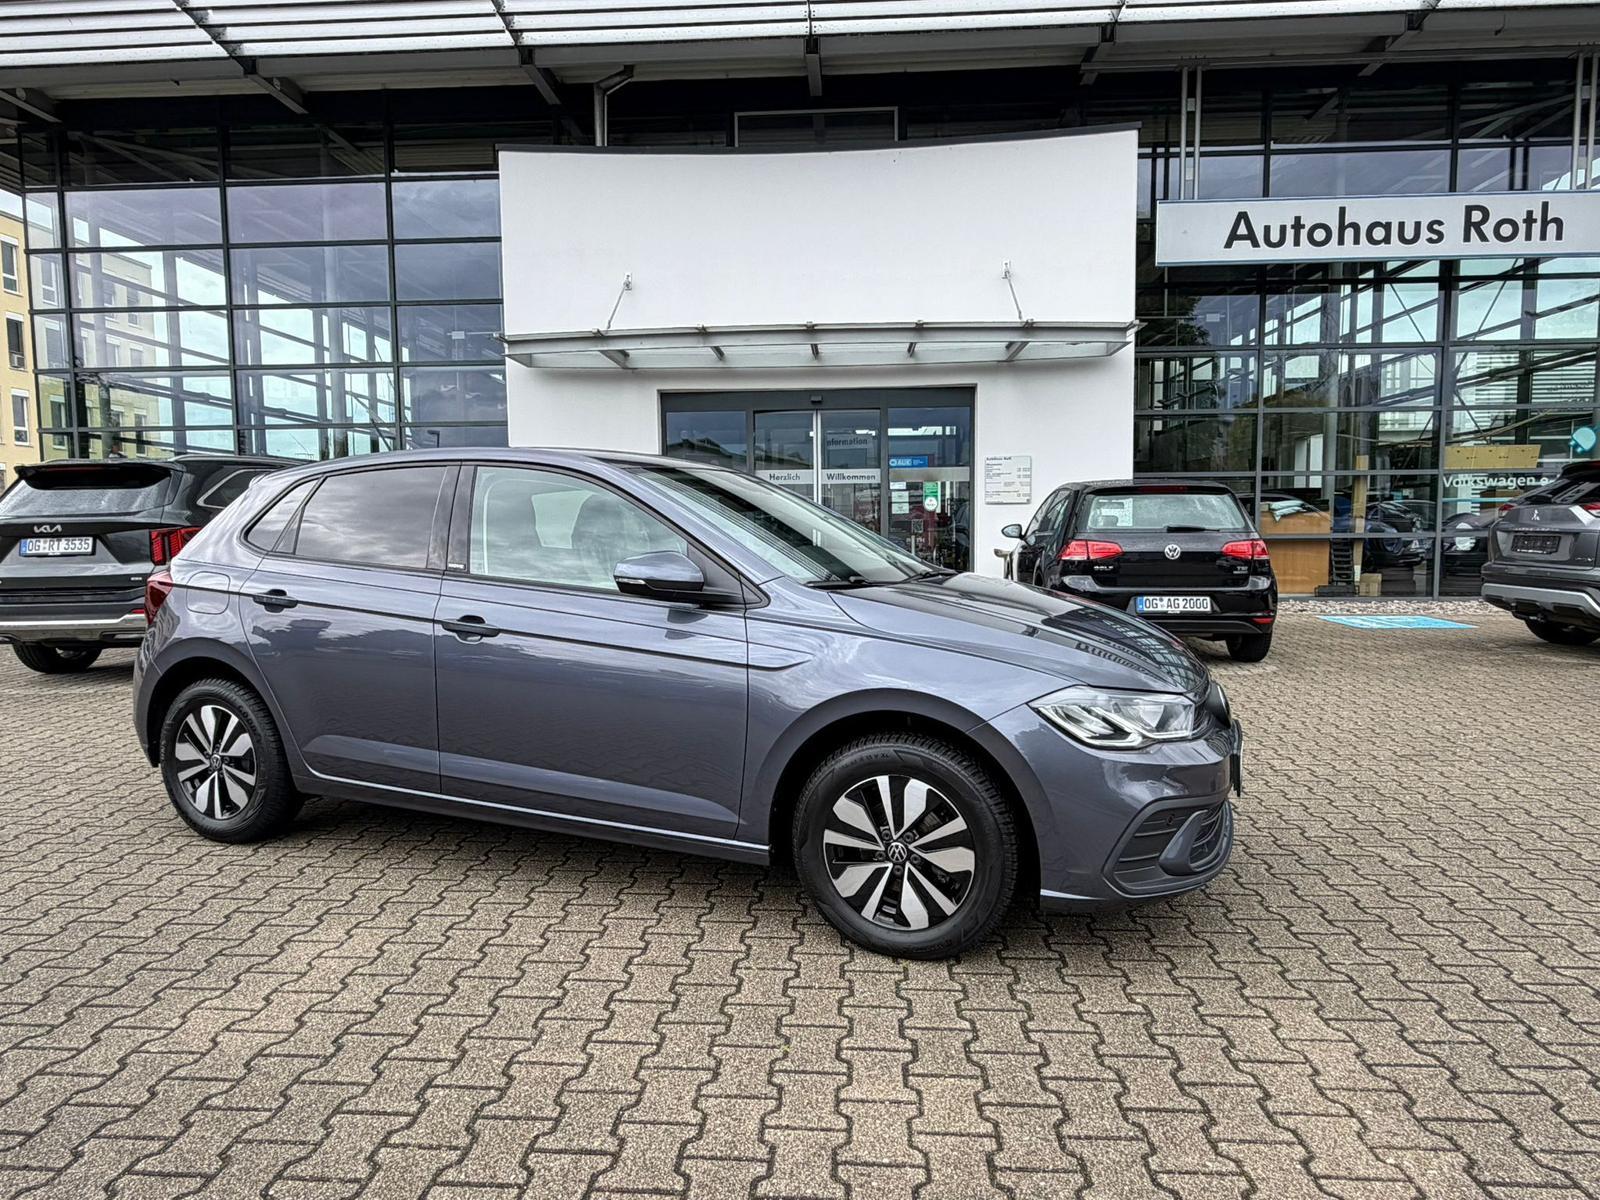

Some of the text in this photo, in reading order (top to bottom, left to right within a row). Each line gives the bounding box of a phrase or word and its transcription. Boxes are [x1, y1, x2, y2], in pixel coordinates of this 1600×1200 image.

[1223, 201, 1564, 249] Autohaus Roth
[826, 438, 868, 447] nformation
[769, 473, 876, 481] Herzlich Willkommen
[1443, 476, 1536, 489] Volkswagen
[28, 538, 90, 551] OG RT 3535
[1144, 598, 1209, 609] OG AG 2000
